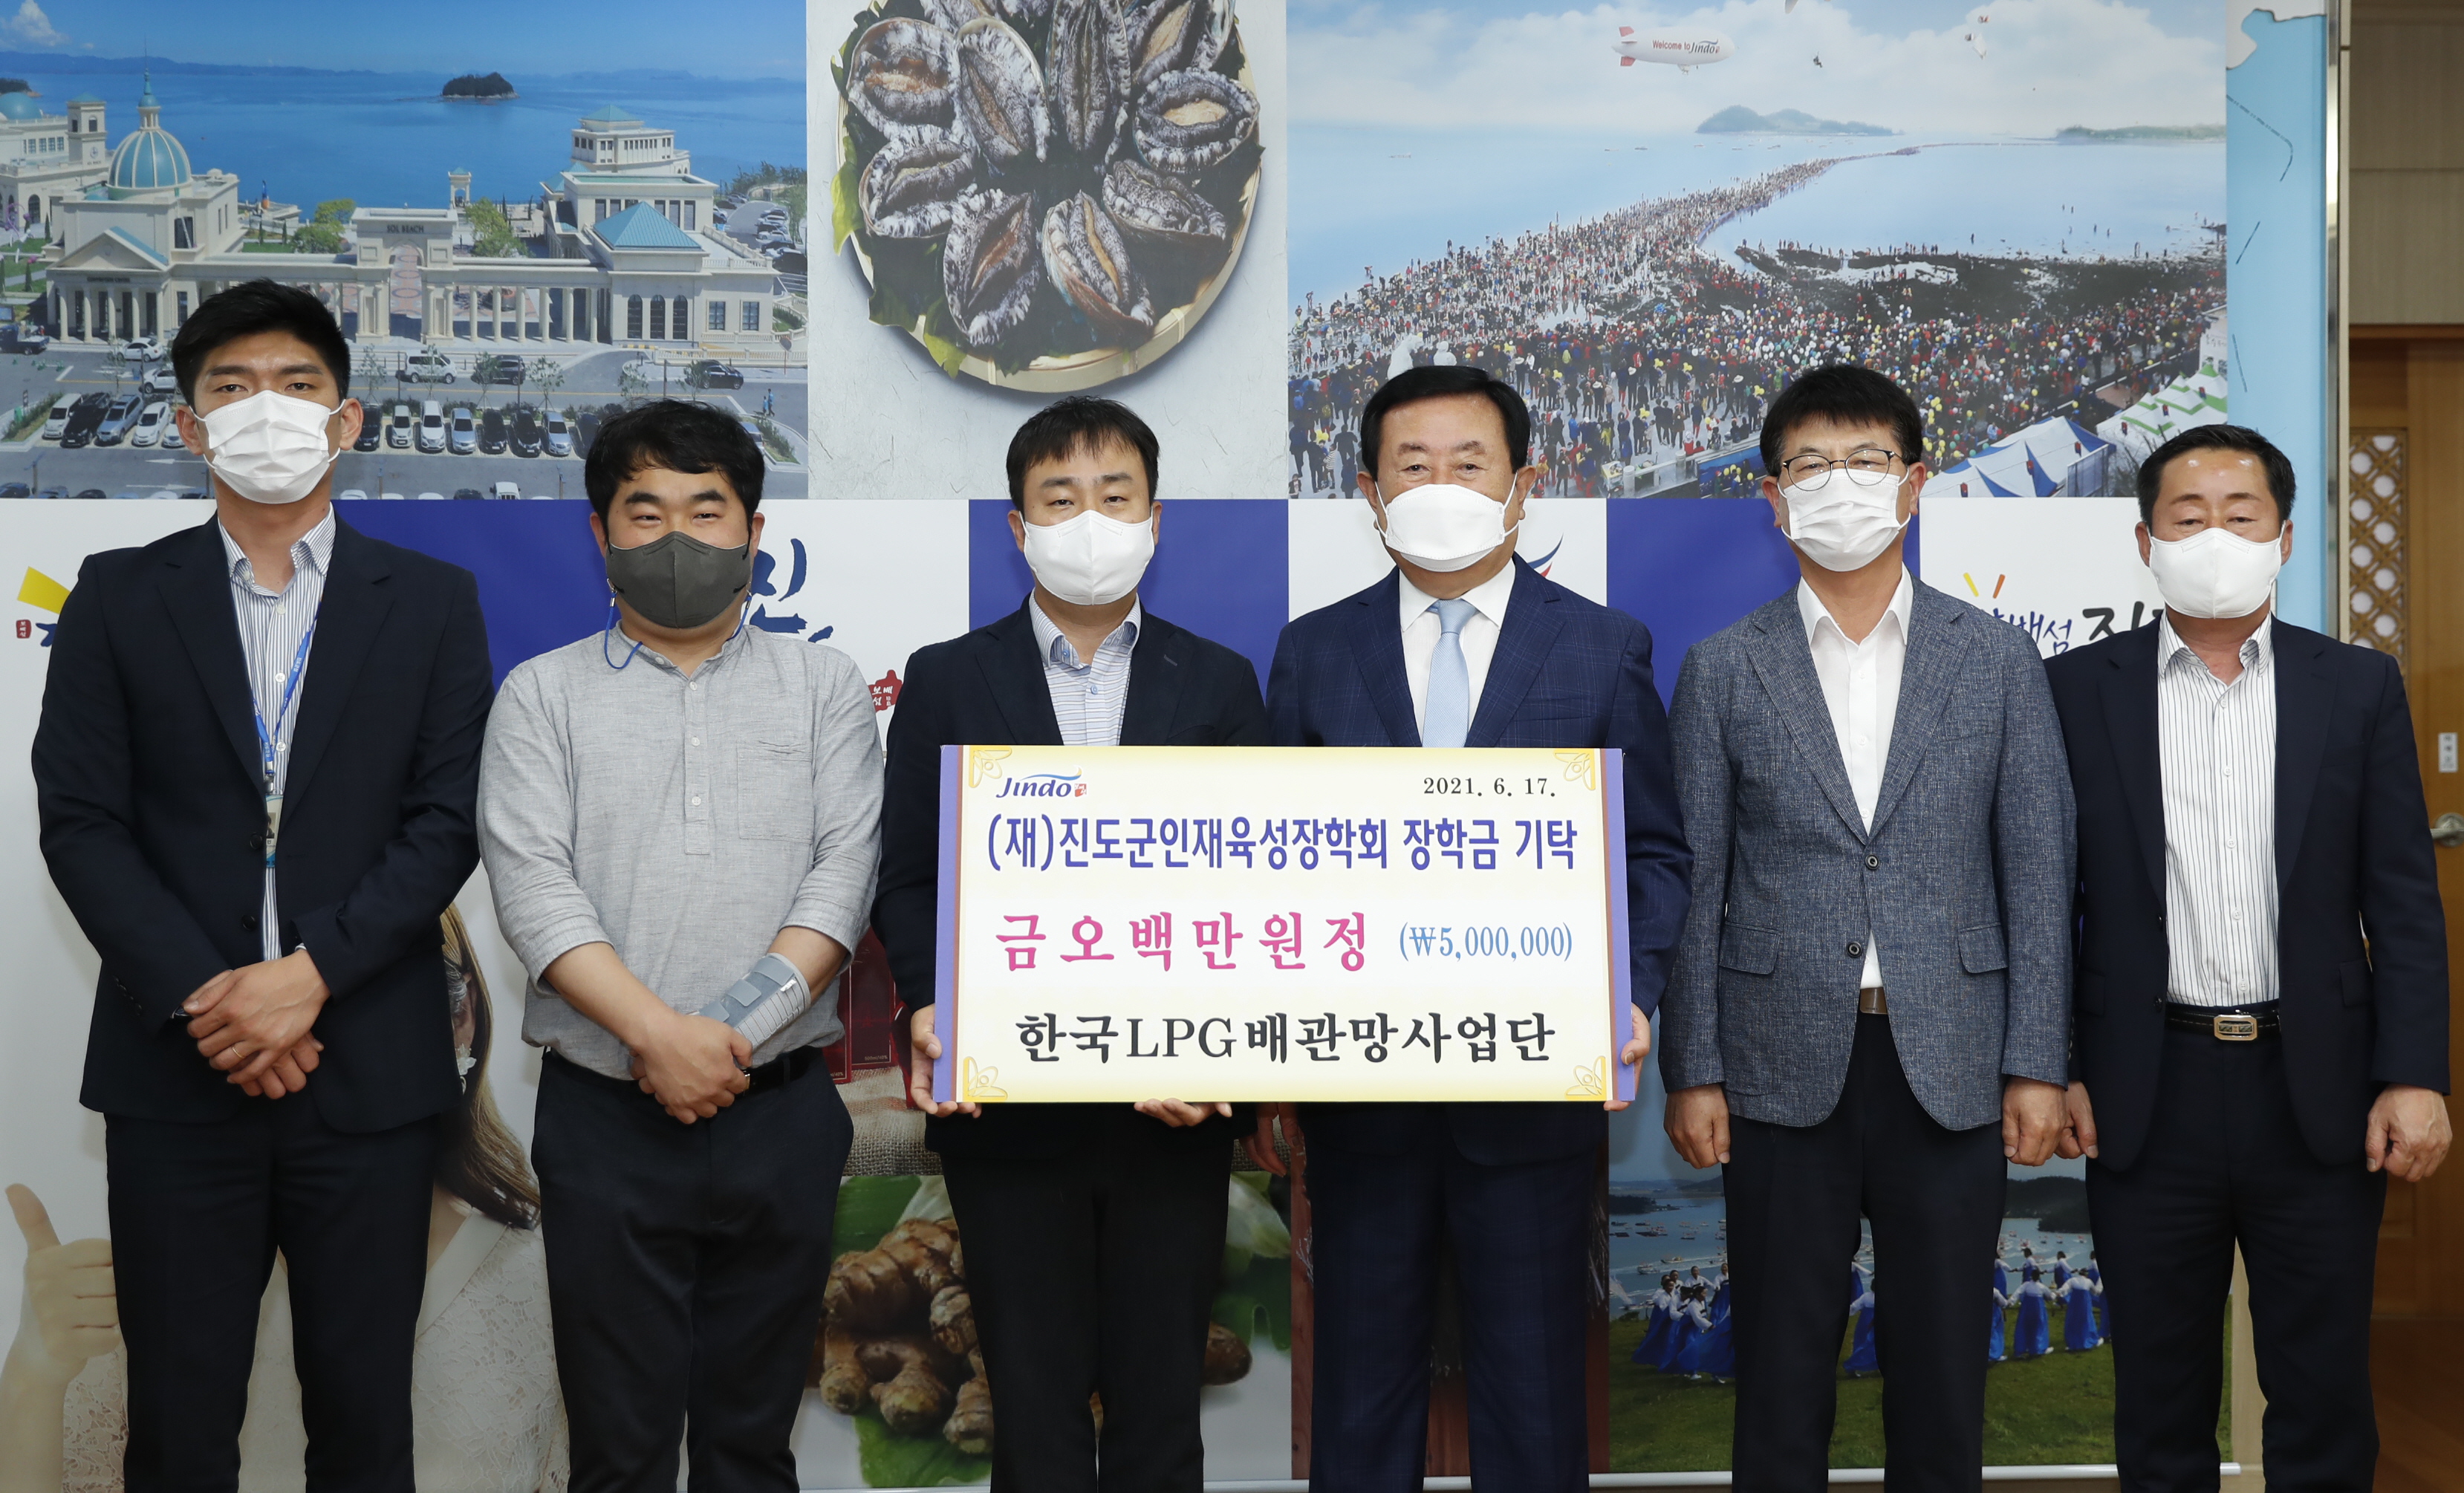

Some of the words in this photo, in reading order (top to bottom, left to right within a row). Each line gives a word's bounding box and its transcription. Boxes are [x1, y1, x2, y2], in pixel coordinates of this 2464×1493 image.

[1652, 39, 1682, 51] Welcome
[1684, 42, 1690, 51] to
[1689, 42, 1715, 54] Jindo
[402, 224, 424, 233] BEACH
[995, 777, 1073, 798] Jindo
[1423, 778, 1483, 797] 2021.
[1493, 778, 1512, 797] 6.
[1524, 778, 1556, 797] 17.
[988, 813, 1388, 871] (재)진도군인재육성장학회
[1402, 817, 1500, 871] 장학금
[1515, 820, 1578, 871] 기탁
[1400, 923, 1573, 961] (₩5,000,000)
[1015, 1012, 1556, 1064] 한국LPG배관망사업단
